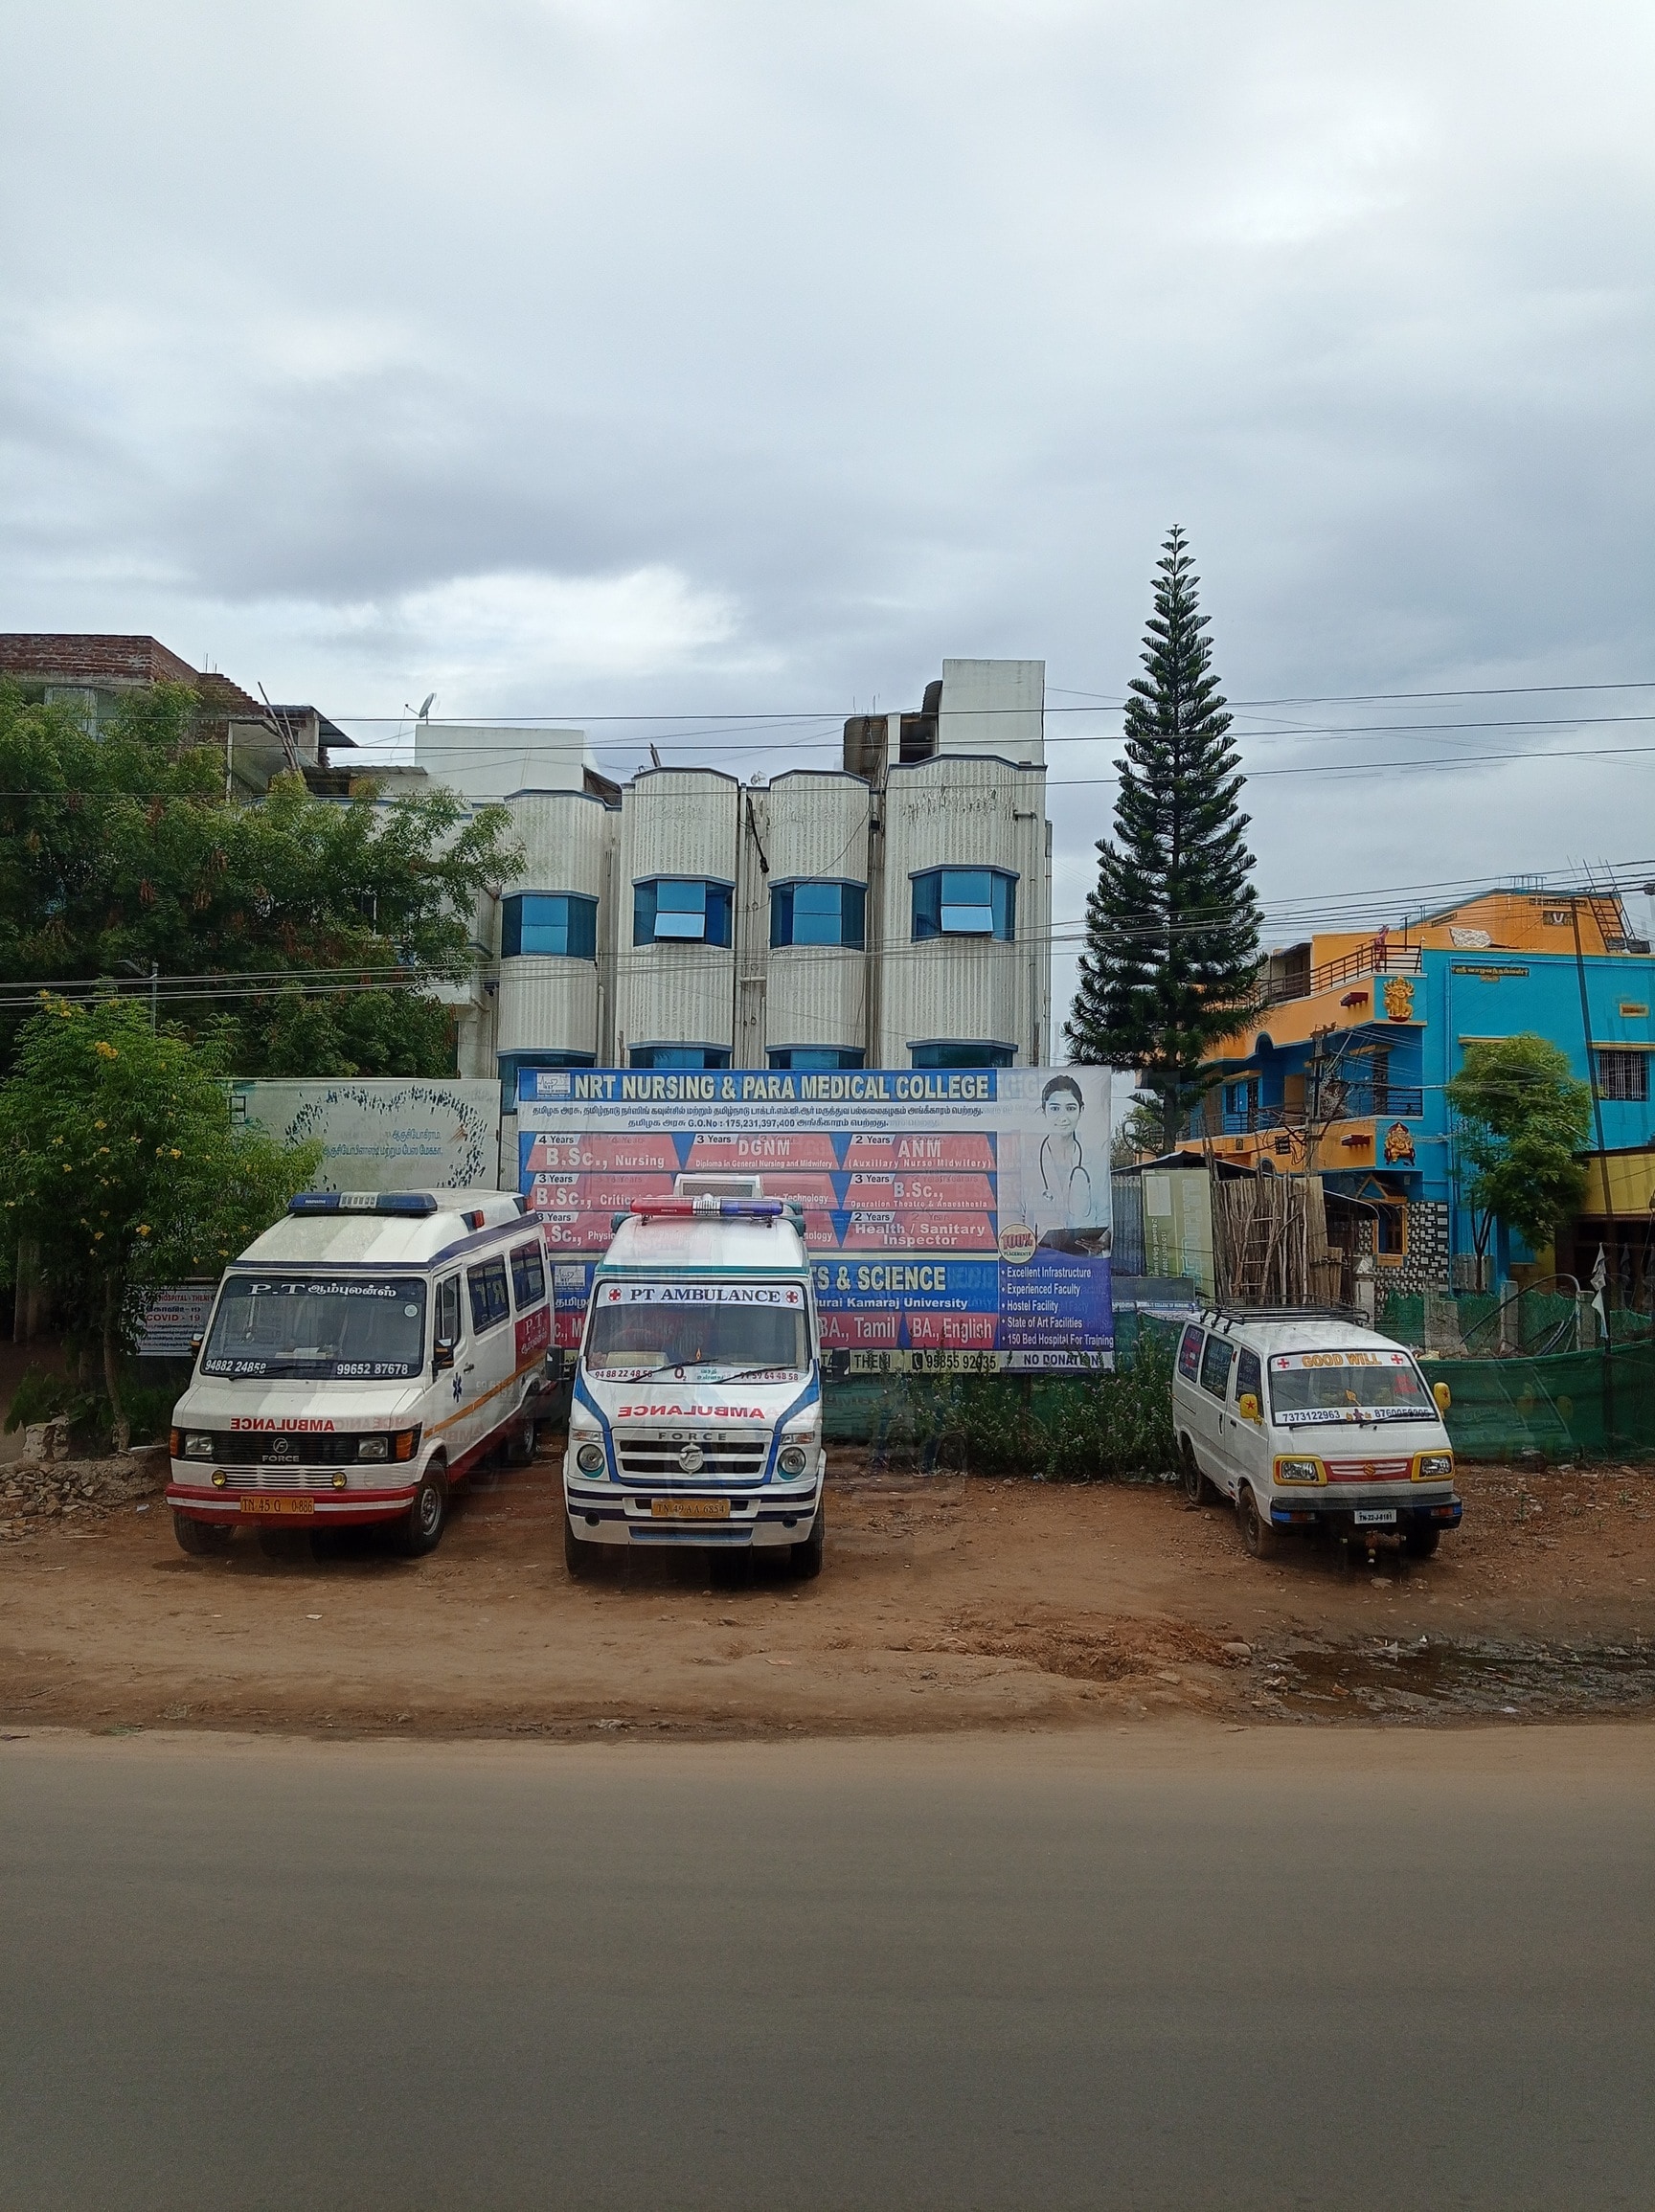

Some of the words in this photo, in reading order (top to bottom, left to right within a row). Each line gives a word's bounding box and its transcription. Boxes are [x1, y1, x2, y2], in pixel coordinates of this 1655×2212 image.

[575, 1074, 616, 1098] NRT
[622, 1075, 714, 1099] NURSING
[721, 1075, 737, 1099] &
[742, 1075, 795, 1099] PARA
[801, 1075, 890, 1099] MEDICAL
[896, 1074, 988, 1099] COLLEGE
[628, 1117, 661, 1129] தமிழக
[538, 1135, 547, 1144] 4
[550, 1135, 575, 1144] Years
[696, 1135, 705, 1144] 3
[708, 1135, 732, 1143] Years
[855, 1136, 863, 1144] 2
[867, 1136, 891, 1144] Years
[738, 1140, 790, 1156] DGNM
[897, 1140, 941, 1158] ANM
[546, 1147, 608, 1170] B.Sc.,
[615, 1154, 665, 1169] Nursing
[695, 1160, 722, 1168] Diploma
[759, 1160, 785, 1168] Nursing
[538, 1174, 547, 1184] 3
[549, 1174, 573, 1184] Years
[854, 1174, 863, 1184] 3
[866, 1174, 890, 1183] Years
[536, 1187, 592, 1208] B.Sc.,
[600, 1193, 641, 1206] Critic
[894, 1182, 943, 1201] B.Sc.,
[850, 1200, 890, 1209] Operation
[894, 1200, 925, 1208] Theatre
[548, 1212, 572, 1222] Years
[854, 1212, 862, 1222] 2
[866, 1212, 891, 1222] Years
[855, 1223, 905, 1234] Health
[919, 1223, 986, 1236] Sanitary
[883, 1234, 958, 1248] Inspector
[1001, 1232, 1033, 1250] 100%
[1007, 1266, 1041, 1277] Excellent
[1041, 1266, 1092, 1277] Infrastructure
[836, 1266, 851, 1290] &
[857, 1266, 946, 1291] SCIENCE
[246, 1283, 306, 1296] P.T
[307, 1282, 397, 1298] ஆம்புலன்ஸ்
[630, 1289, 655, 1301] PT
[660, 1289, 781, 1303] AMBULANCE
[1007, 1283, 1053, 1297] Experienced
[1054, 1283, 1081, 1297] Faculty
[847, 1298, 900, 1310] Kamaraj
[903, 1298, 968, 1310] University
[1007, 1299, 1031, 1311] Hostel
[1032, 1299, 1058, 1314] Facility
[853, 1317, 896, 1338] Tamil
[1007, 1317, 1027, 1328] State
[1028, 1317, 1035, 1327] of
[1036, 1317, 1049, 1327] Art
[1050, 1317, 1083, 1328] Facilities
[943, 1318, 992, 1343] English
[1008, 1334, 1021, 1344] 150
[1022, 1334, 1037, 1344] Bed
[1038, 1334, 1069, 1347] Hospital
[1070, 1334, 1082, 1344] For
[1084, 1334, 1114, 1347] Training
[1023, 1354, 1039, 1366] NO
[1302, 1354, 1344, 1368] GOOD
[1345, 1353, 1383, 1366] WILL
[204, 1360, 233, 1372] 94882
[337, 1364, 371, 1375] 99652
[374, 1363, 409, 1375] 87678
[1282, 1410, 1341, 1422] 7373122963
[658, 1432, 727, 1441] FORCE
[242, 1499, 255, 1511] TN
[259, 1499, 271, 1511] 45
[657, 1503, 669, 1512] TN
[673, 1503, 685, 1513] 49
